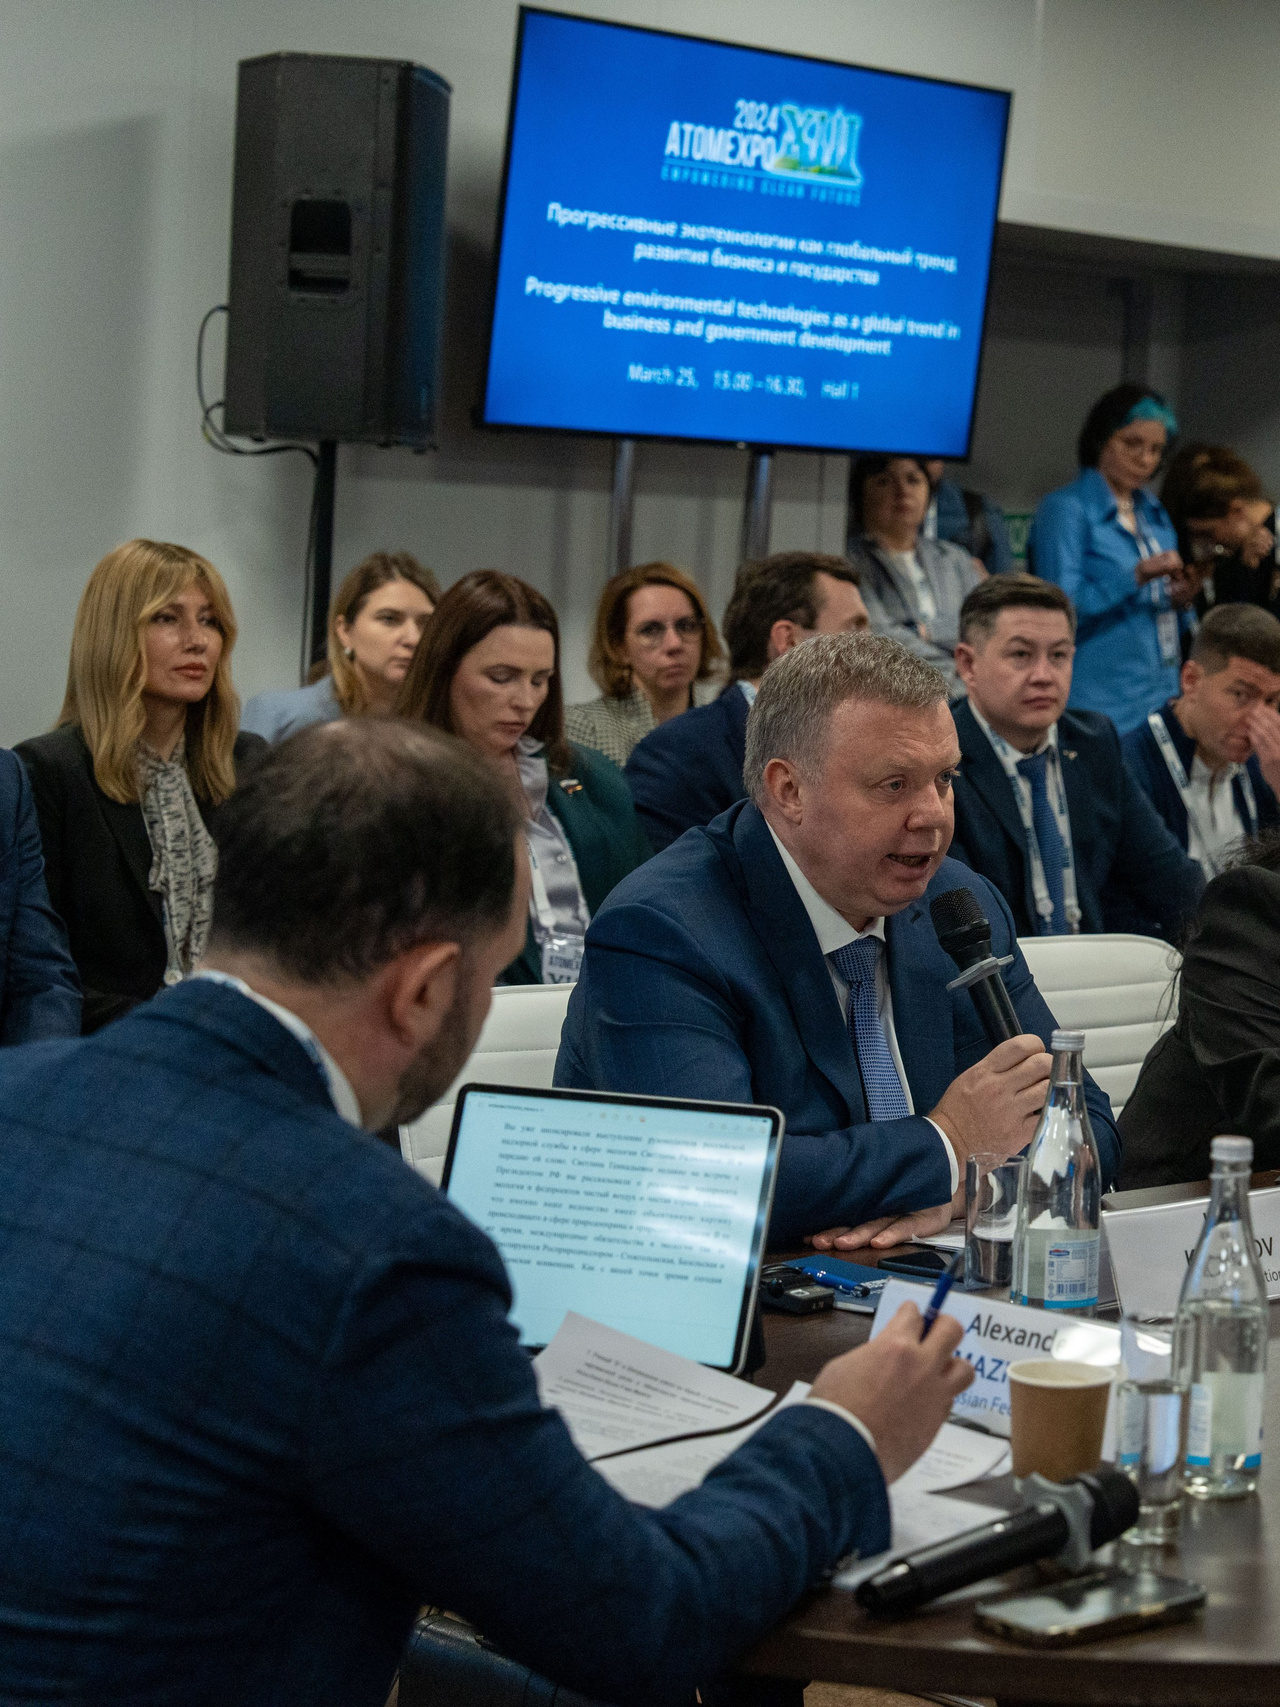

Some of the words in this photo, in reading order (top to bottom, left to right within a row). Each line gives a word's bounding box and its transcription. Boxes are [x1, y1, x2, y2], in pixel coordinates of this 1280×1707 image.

[733, 98, 779, 132] 2024
[664, 119, 777, 171] ATOMEXPO
[546, 201, 678, 238] Прогрессивные
[679, 222, 798, 250] экотехнологии
[798, 237, 826, 255] как
[826, 239, 914, 267] глобальный
[914, 251, 959, 274] тренд
[633, 241, 710, 265] развития
[711, 246, 776, 274] бизнеса
[788, 259, 881, 286] государства
[524, 274, 622, 304] Progressive
[622, 287, 737, 318] environmental
[735, 297, 831, 330] technologies
[831, 311, 849, 330] as
[861, 310, 905, 336] global
[906, 315, 946, 340] trend
[602, 307, 671, 335] business
[672, 316, 706, 338] and
[704, 321, 798, 347] government
[797, 327, 893, 357] development
[966, 1312, 1068, 1353] Alexand
